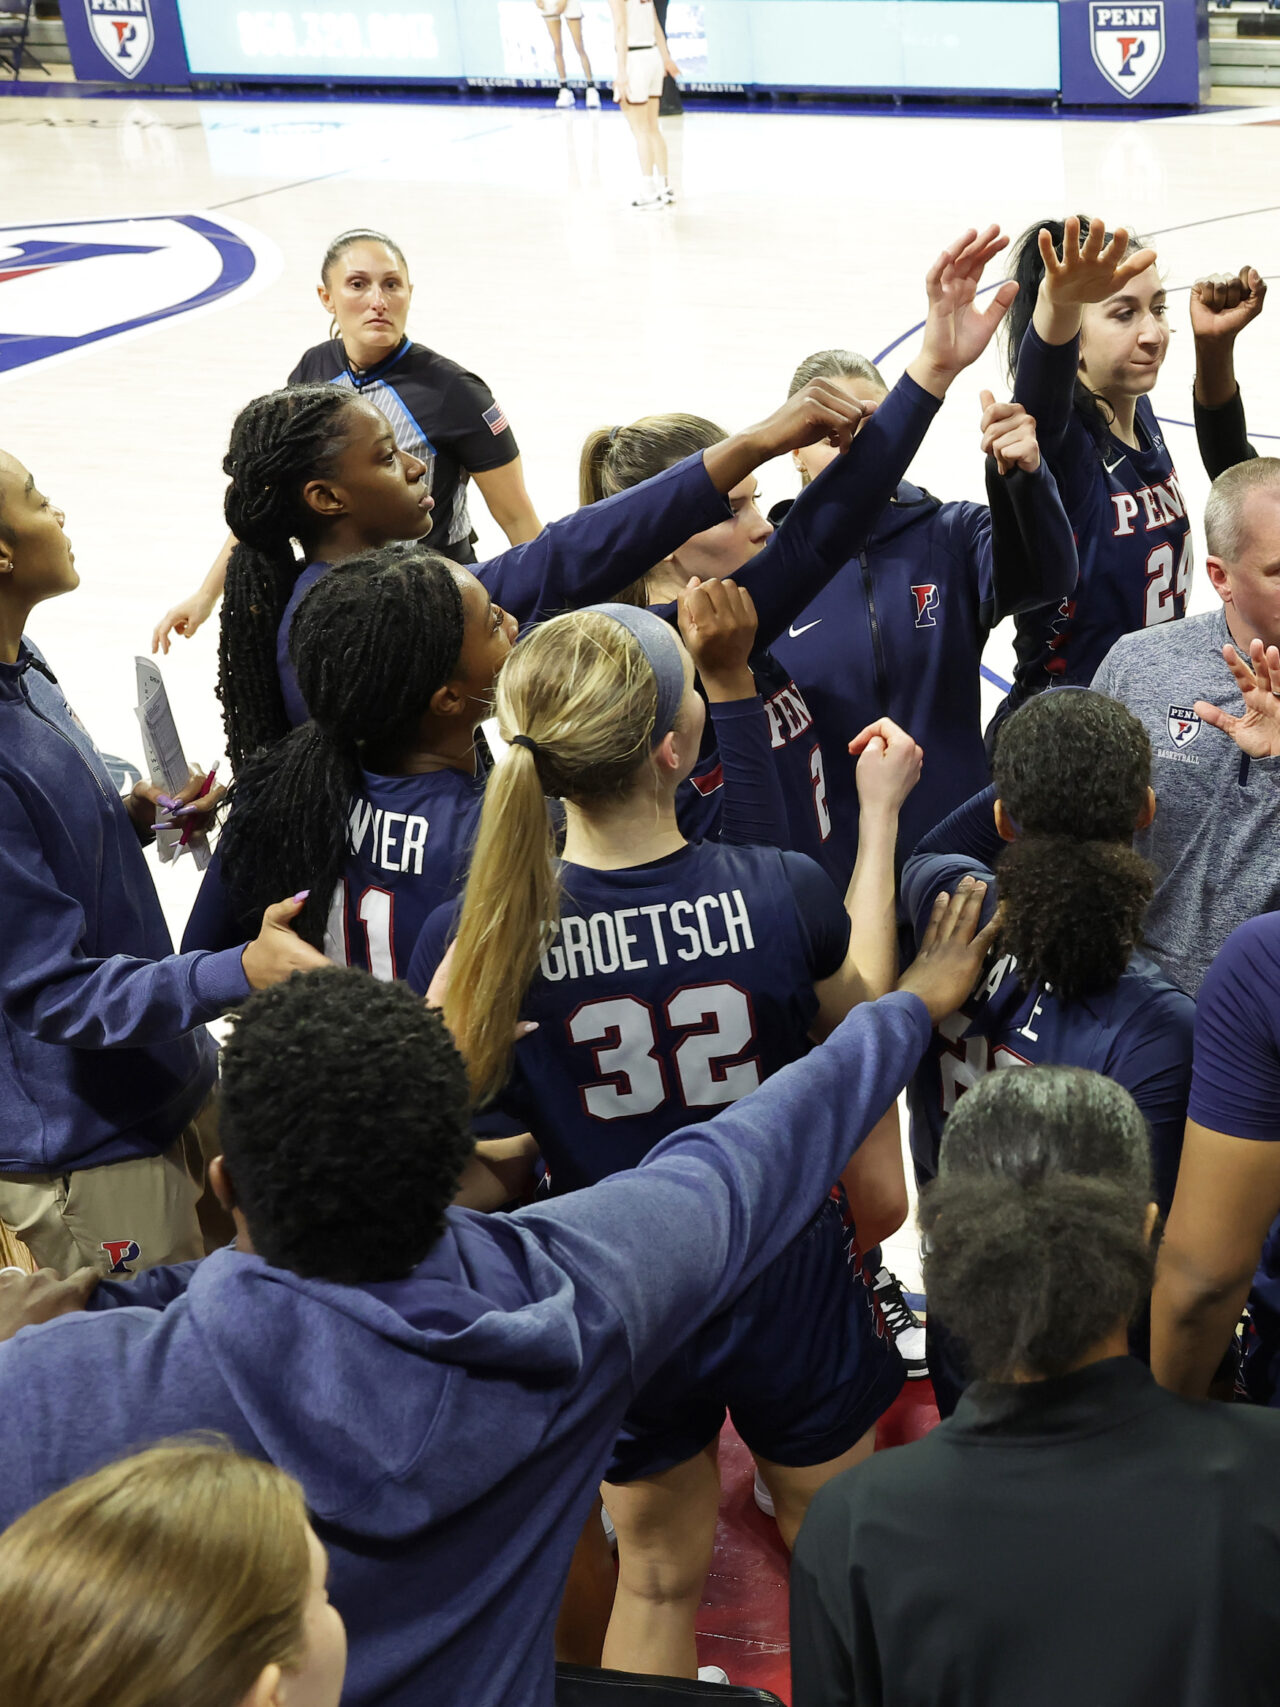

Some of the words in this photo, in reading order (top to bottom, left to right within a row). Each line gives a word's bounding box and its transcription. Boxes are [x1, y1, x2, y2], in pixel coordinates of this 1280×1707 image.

[1097, 8, 1157, 26] PENN
[1117, 37, 1145, 76] P
[467, 78, 517, 88] WELCOME
[521, 79, 537, 88] TO
[690, 83, 744, 93] PALESTRA
[1109, 467, 1188, 537] PEN
[1143, 530, 1194, 628] 24
[911, 584, 940, 628] P
[763, 680, 813, 750] PEN
[1170, 708, 1199, 720] PENN
[1157, 748, 1200, 765] BASKETBALL
[345, 797, 429, 875] WYER
[539, 889, 755, 981] GROETSCH
[564, 979, 763, 1120] 32
[101, 1240, 141, 1273] P
